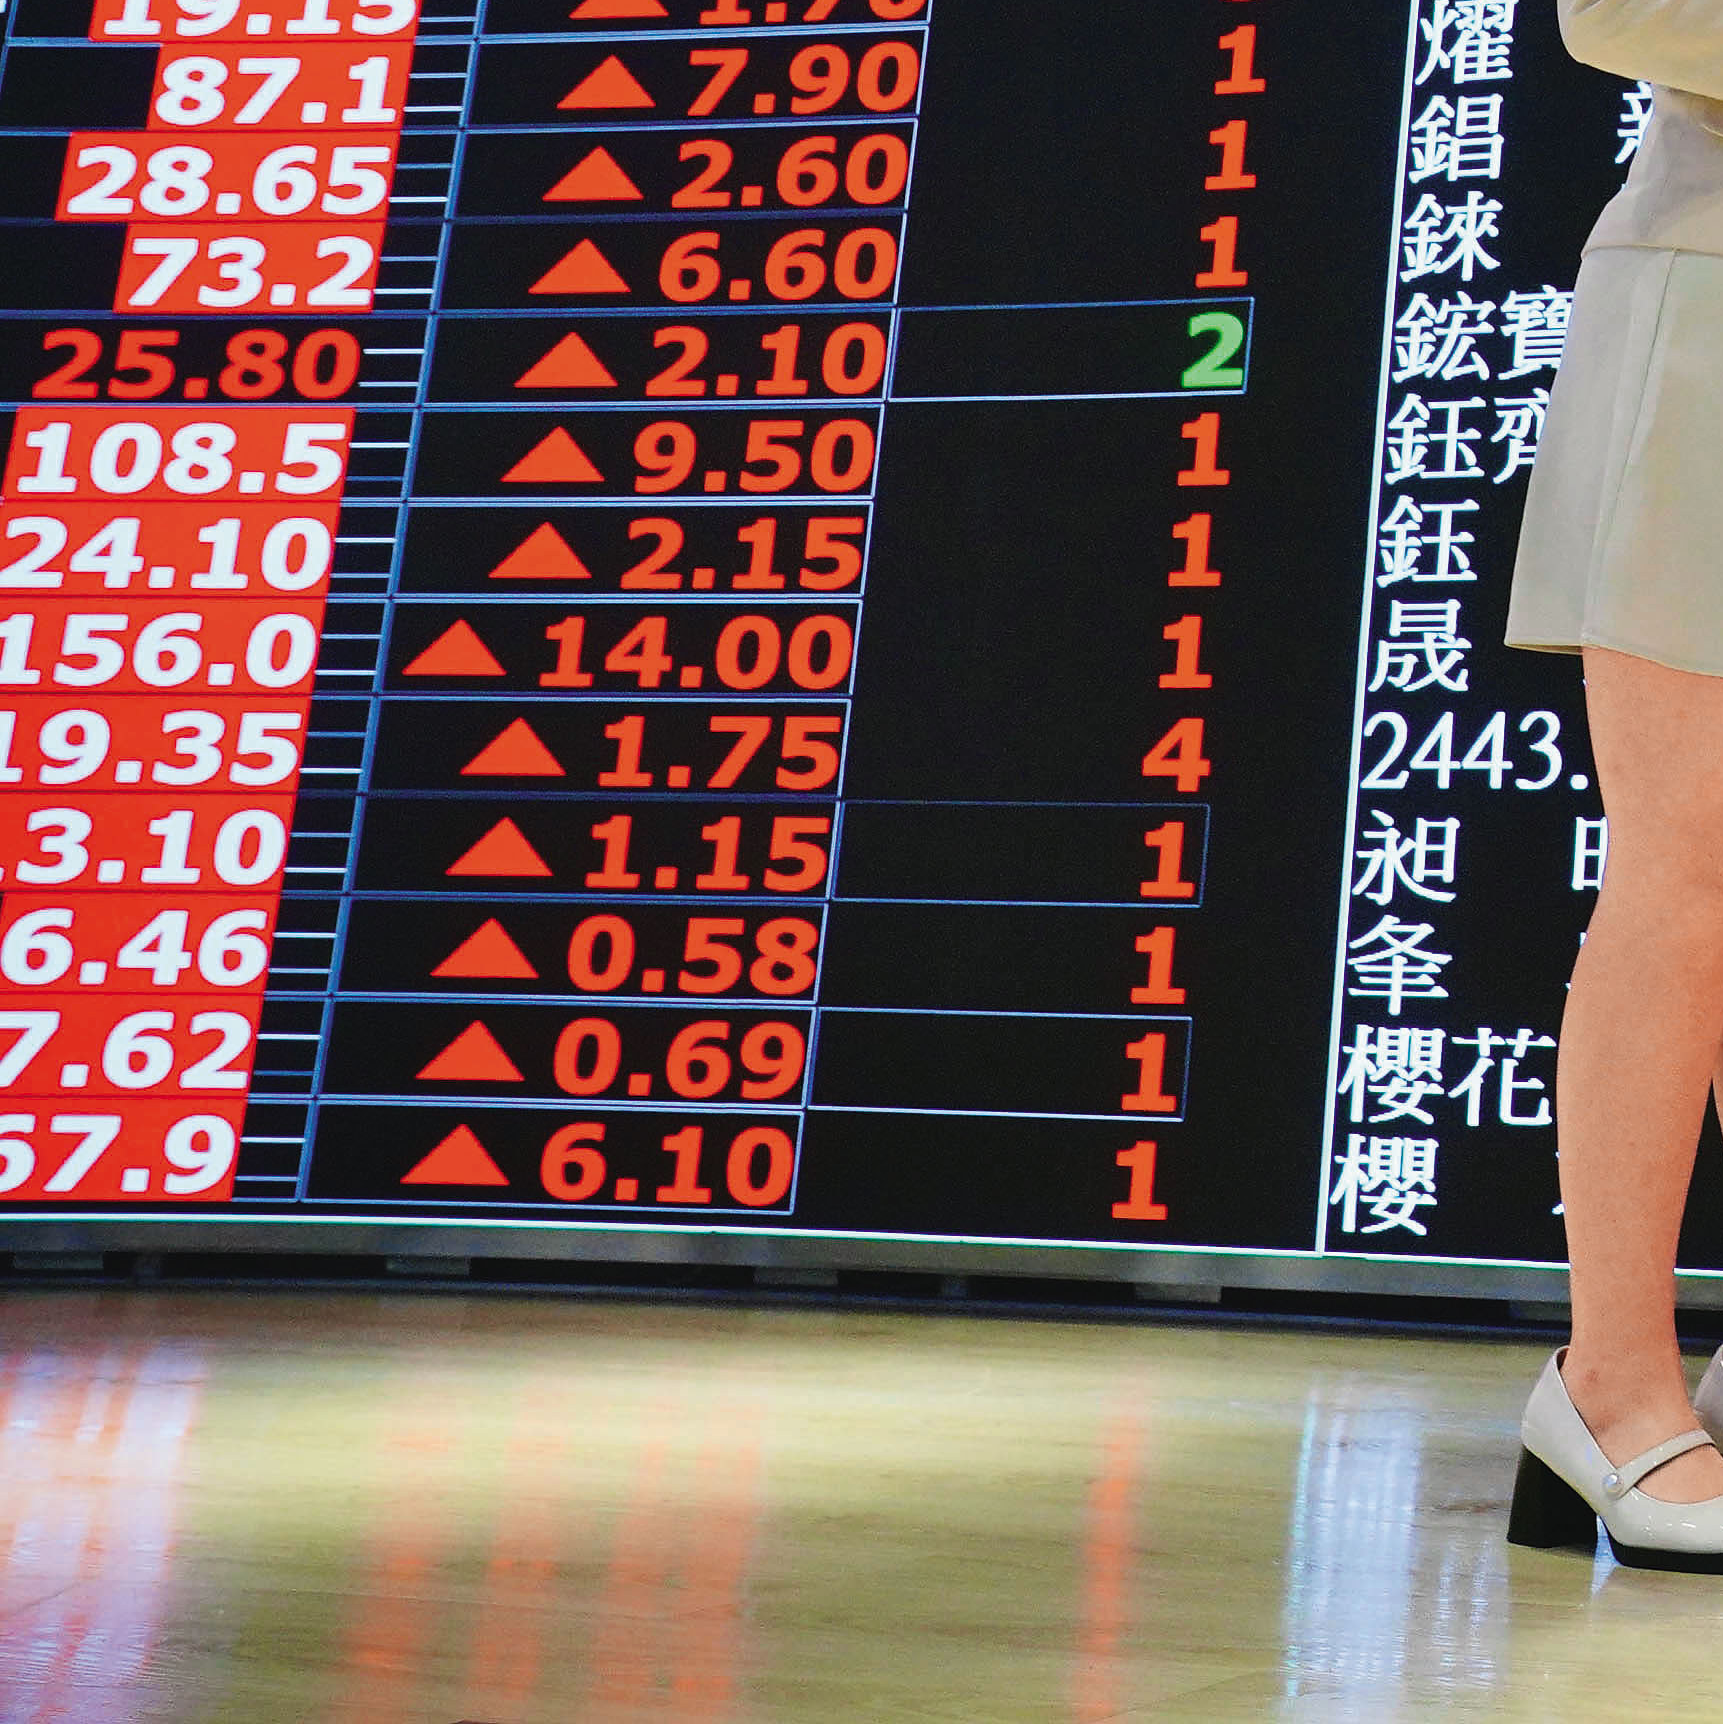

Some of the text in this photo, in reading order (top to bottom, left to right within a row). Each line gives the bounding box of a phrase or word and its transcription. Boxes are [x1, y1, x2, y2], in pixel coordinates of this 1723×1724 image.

[156, 57, 395, 125] 87.1
[68, 146, 390, 215] 28.65
[32, 329, 360, 399] 25.80
[1182, 312, 1243, 388] 2
[18, 423, 345, 494] 108.5
[540, 615, 852, 689] 14.00
[598, 716, 841, 790] 1.75
[1142, 718, 1210, 792] 4
[1361, 707, 1588, 790] 2443.
[1, 909, 267, 986] 6.46
[568, 915, 818, 994] 0.58
[541, 1123, 793, 1206] 6.10
